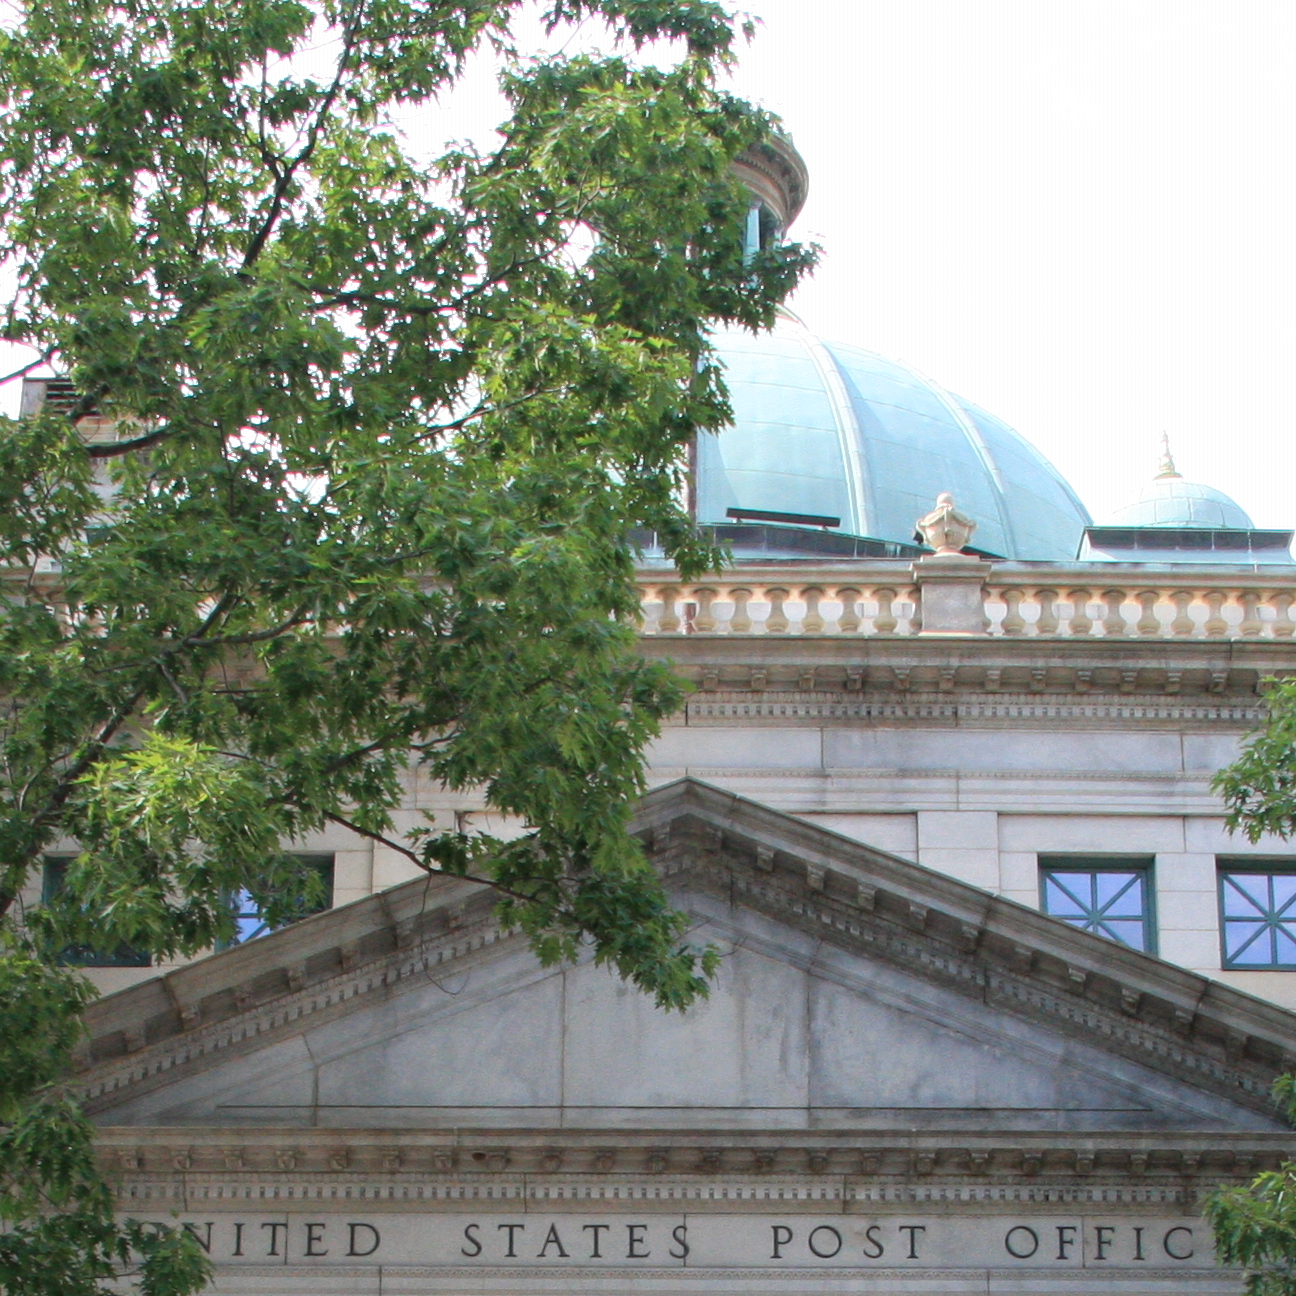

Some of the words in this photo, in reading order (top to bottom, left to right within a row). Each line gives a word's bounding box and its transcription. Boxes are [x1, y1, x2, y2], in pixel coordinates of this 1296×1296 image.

[134, 1221, 381, 1257] NITED
[460, 1223, 690, 1260] STATES
[769, 1224, 926, 1260] POST
[1004, 1225, 1238, 1261] OFFIC
